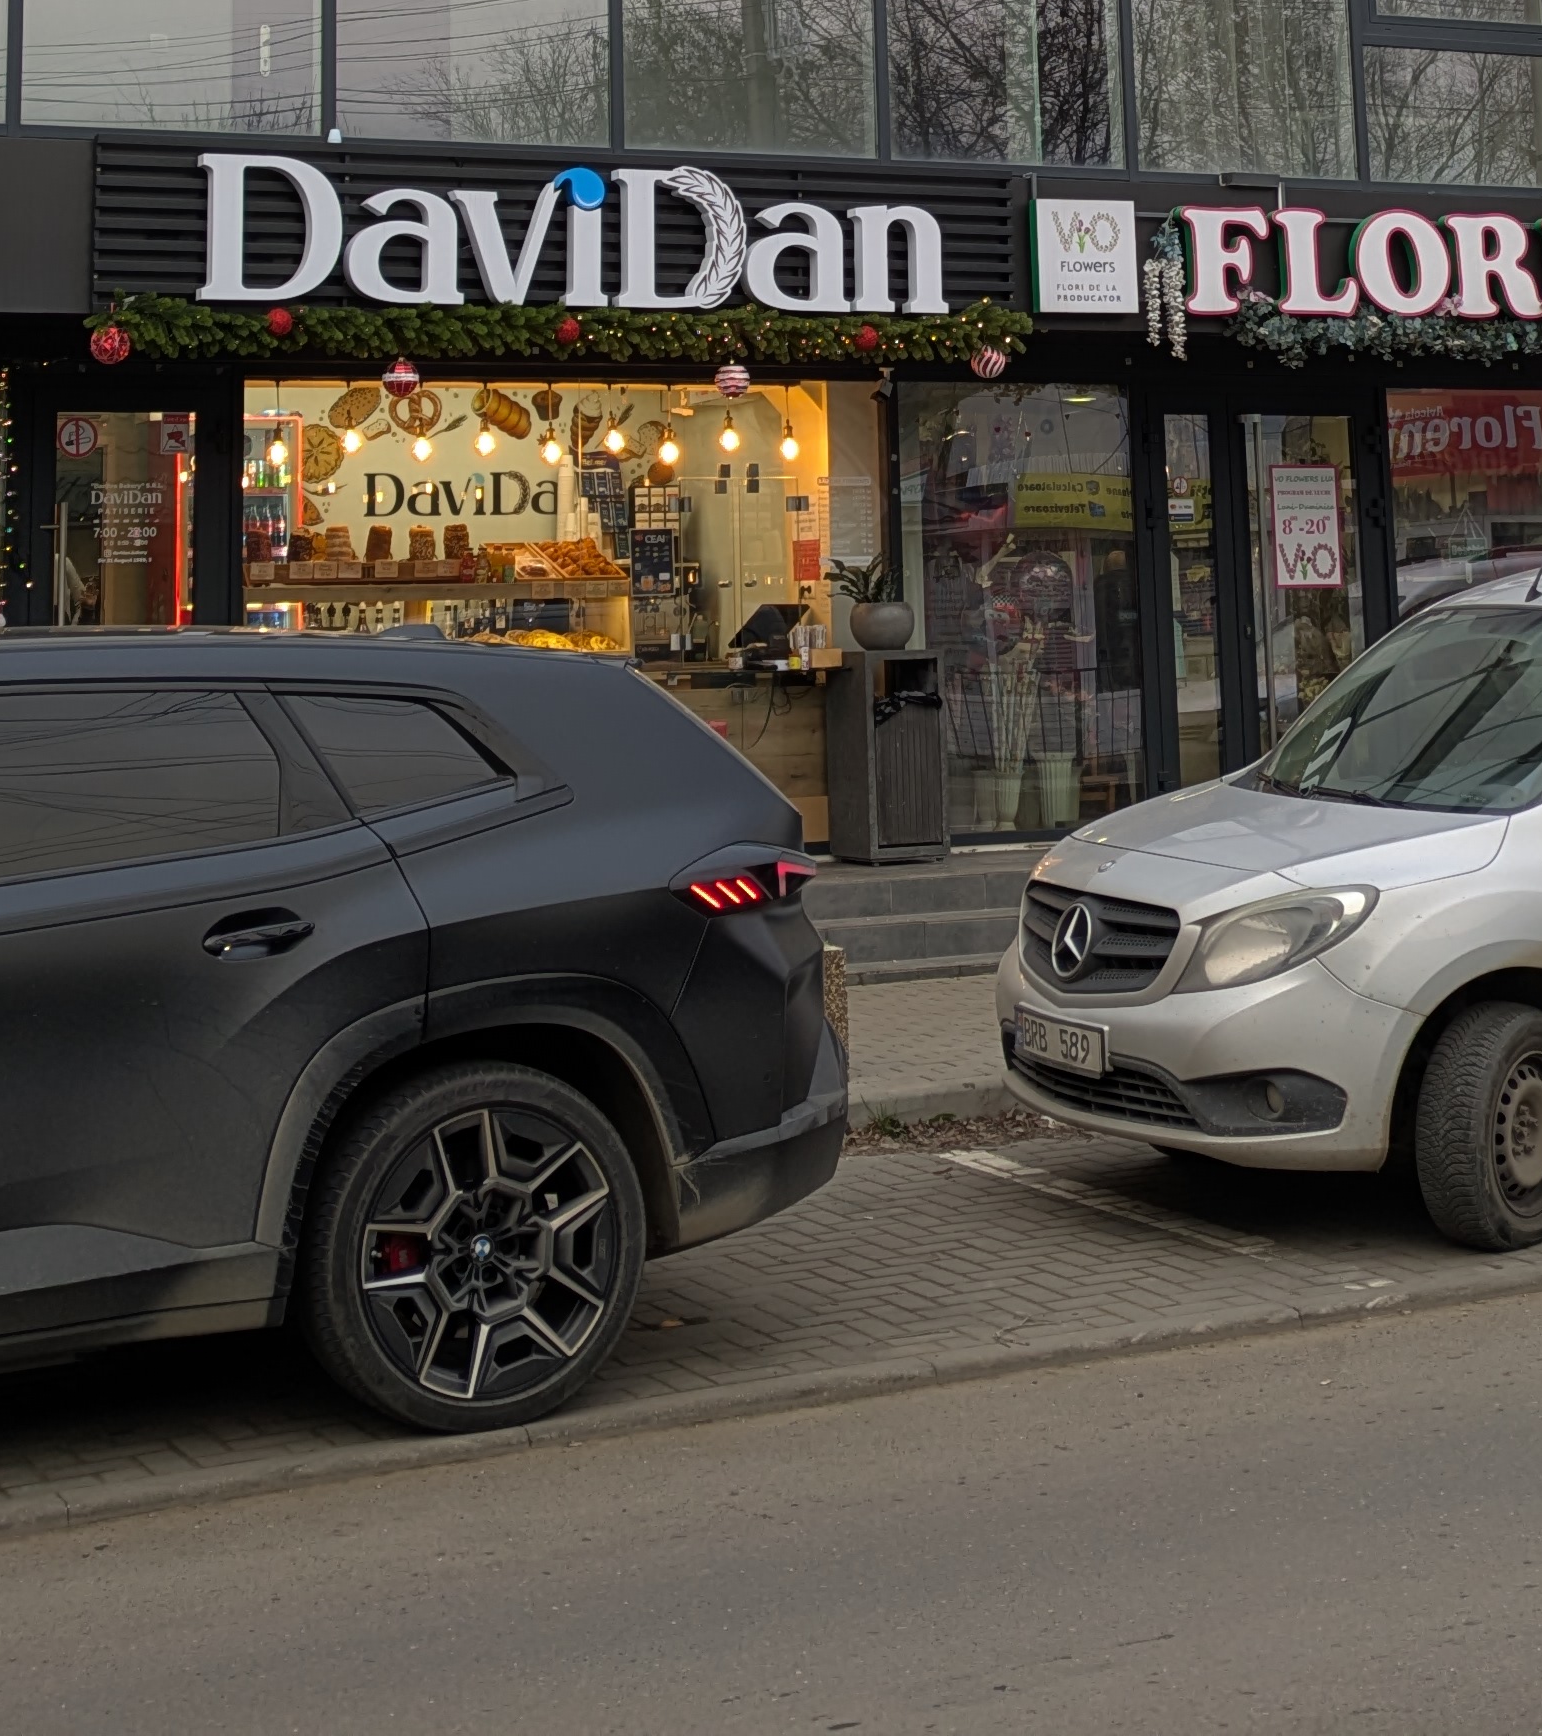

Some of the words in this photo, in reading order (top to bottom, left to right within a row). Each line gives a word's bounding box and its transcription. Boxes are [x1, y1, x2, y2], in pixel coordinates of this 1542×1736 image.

[195, 153, 950, 313] DaviDan
[1056, 283, 1084, 291] FLORI
[1088, 284, 1101, 292] DE
[1105, 284, 1117, 292] LA
[1056, 294, 1122, 303] PRODUCATOR
[90, 490, 162, 505] DaviDan
[363, 470, 558, 518] DaviDa
[93, 527, 117, 538] 7:00
[1023, 1016, 1048, 1053] BRB
[1059, 1028, 1090, 1065] 589
